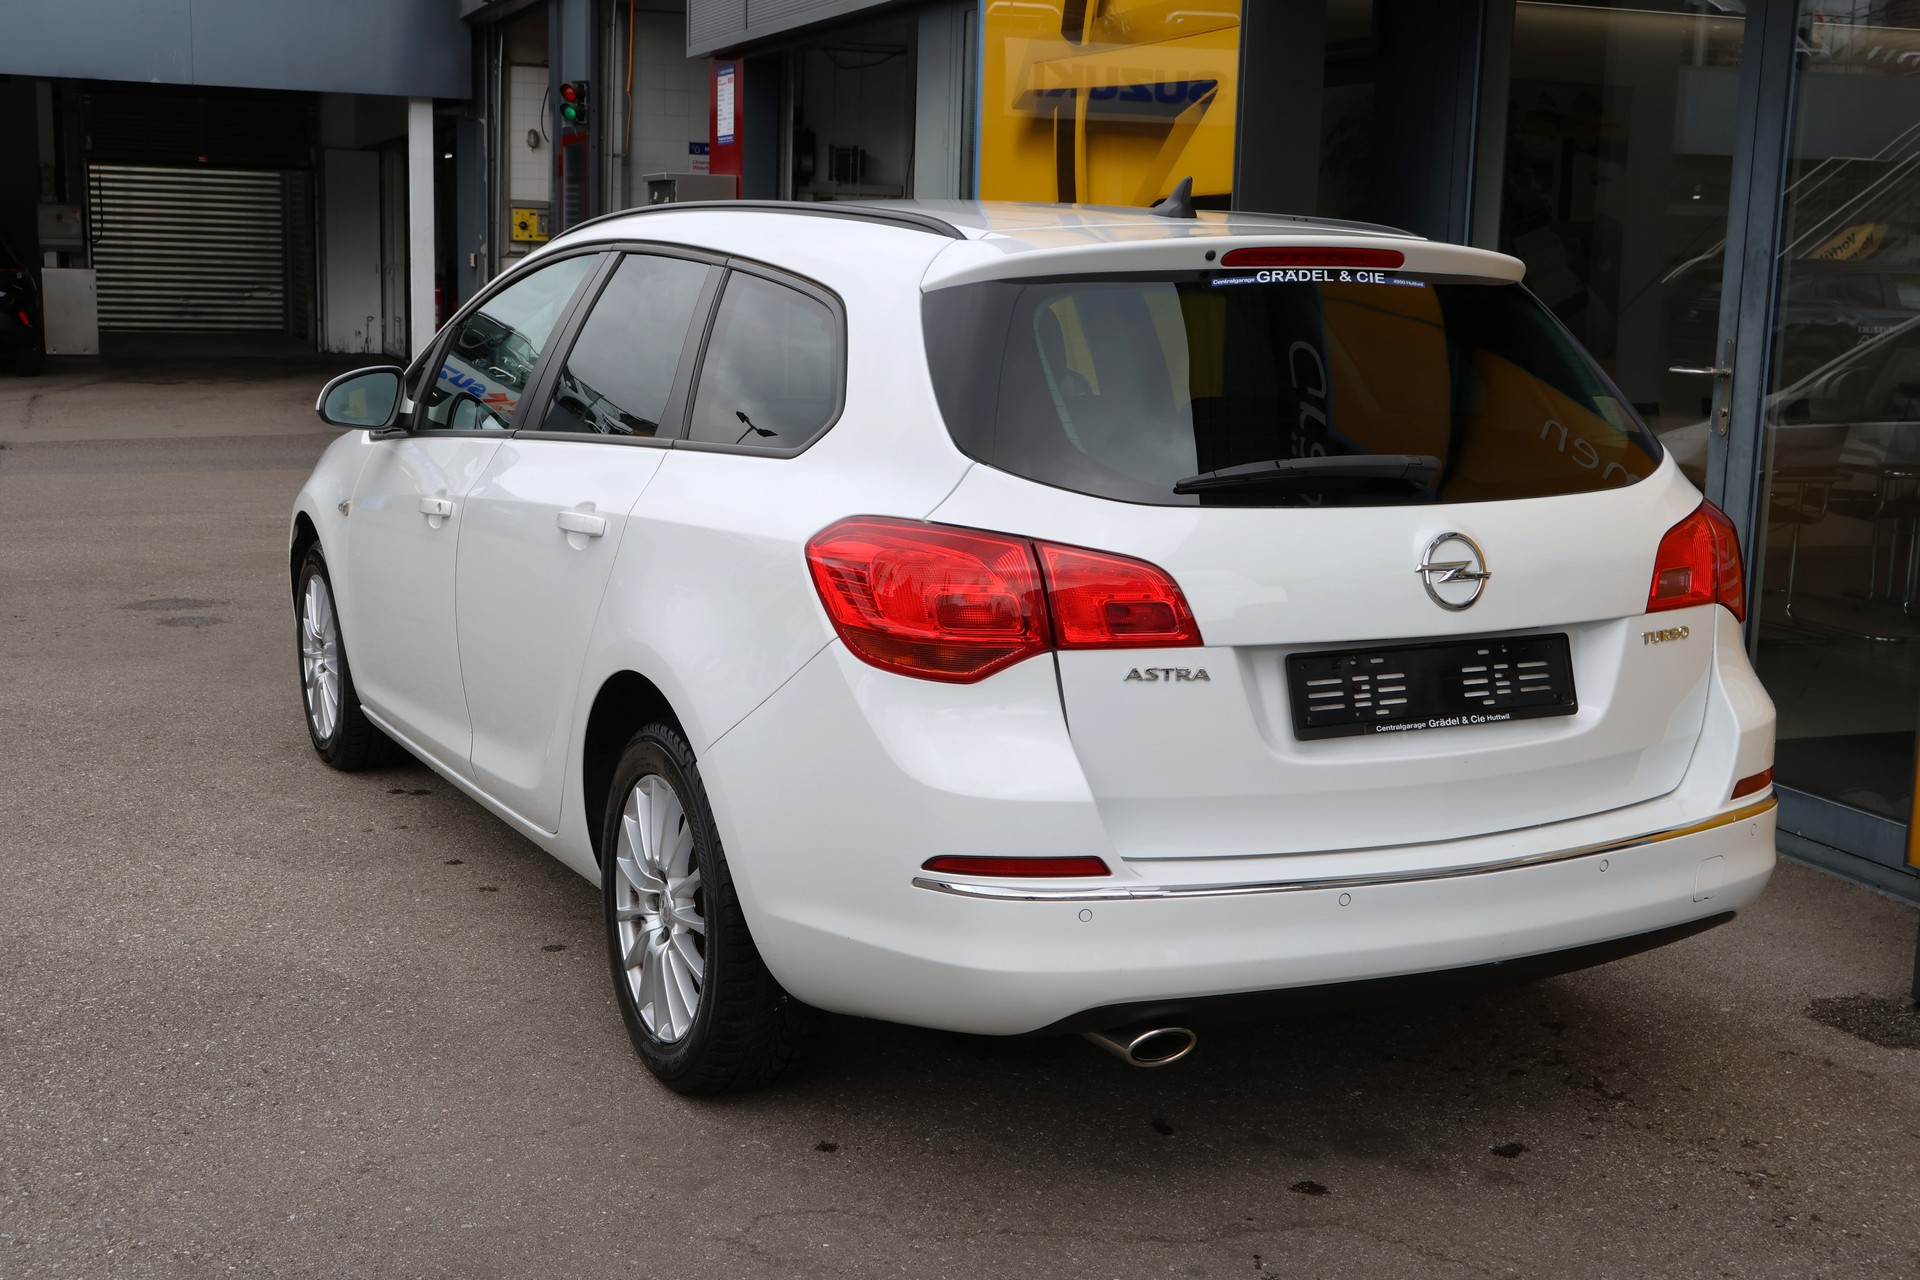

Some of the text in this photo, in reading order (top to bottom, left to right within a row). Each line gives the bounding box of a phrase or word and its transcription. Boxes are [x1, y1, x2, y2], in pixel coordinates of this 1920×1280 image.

[1256, 269, 1334, 283] GRÄDEL
[1339, 270, 1352, 283] &
[1356, 271, 1386, 284] CIE
[1641, 626, 1690, 645] TURBO
[1123, 667, 1211, 682] ASTRA
[1375, 713, 1510, 732] Centralgarage Grädel & Cie Huttwil
